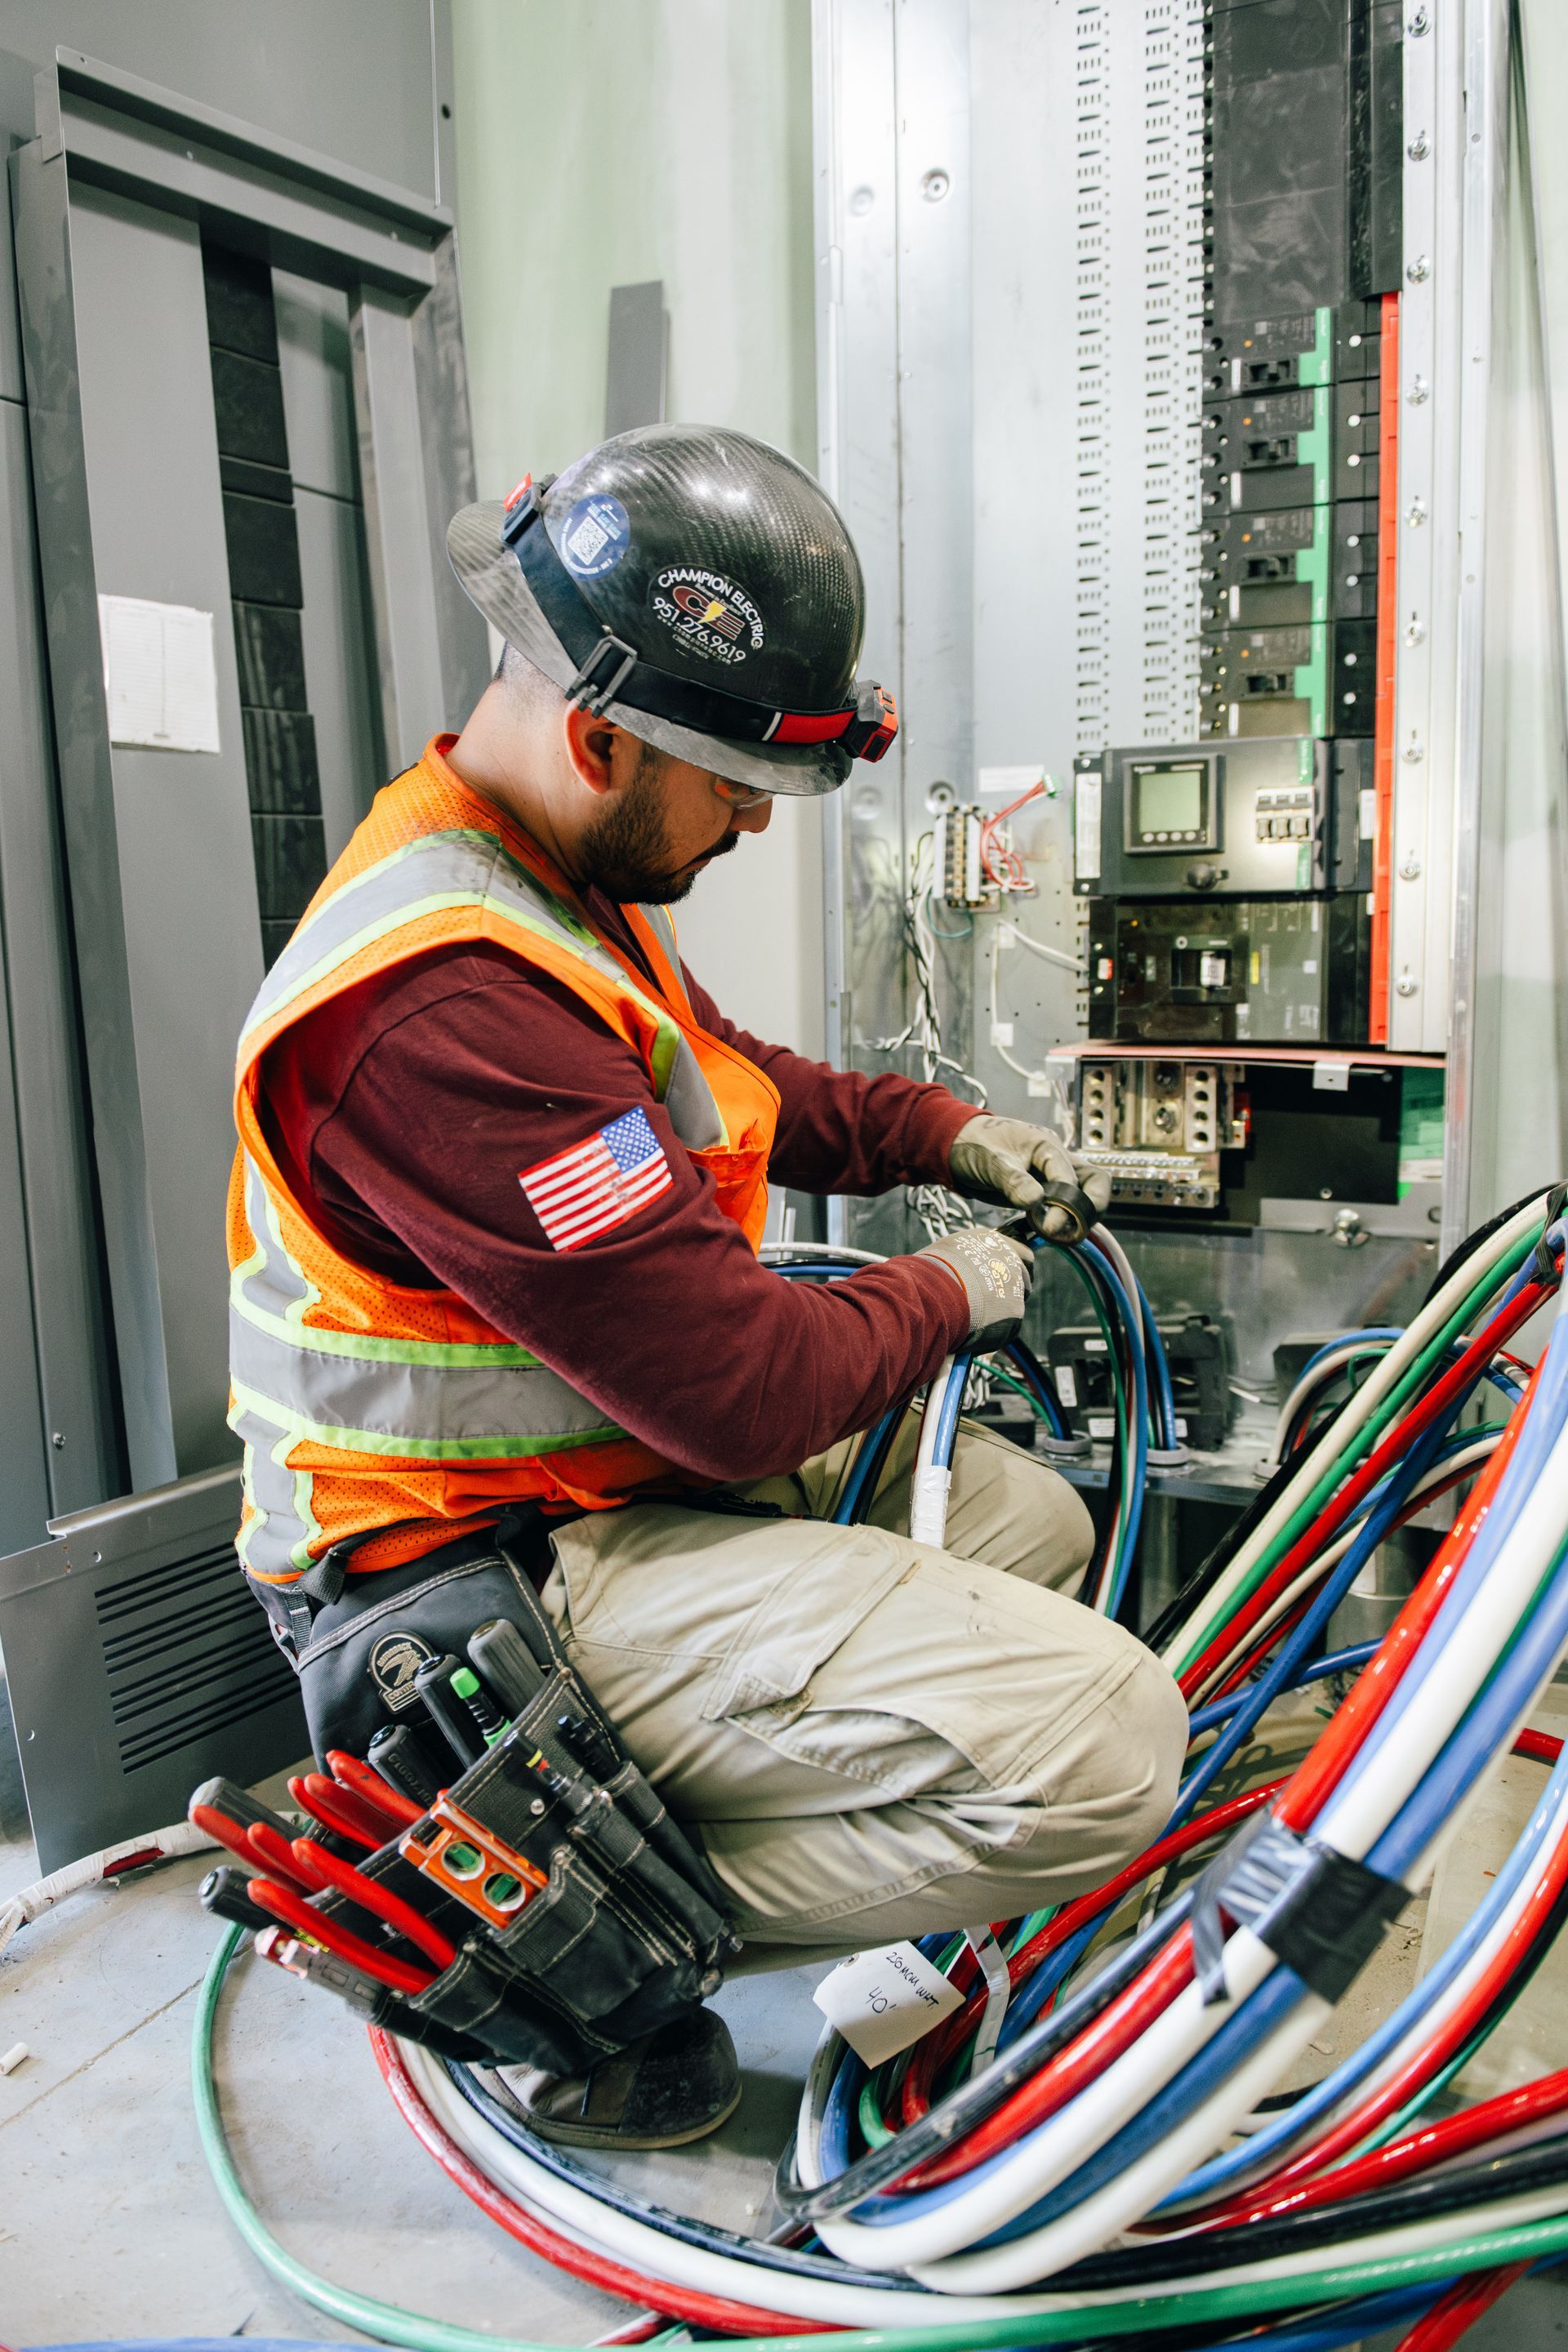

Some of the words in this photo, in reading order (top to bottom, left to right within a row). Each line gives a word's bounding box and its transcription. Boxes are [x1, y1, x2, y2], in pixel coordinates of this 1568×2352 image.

[653, 597, 746, 662] 951.276.9619
[657, 568, 733, 596] CHAMPION
[730, 590, 764, 649] ELECTRIC
